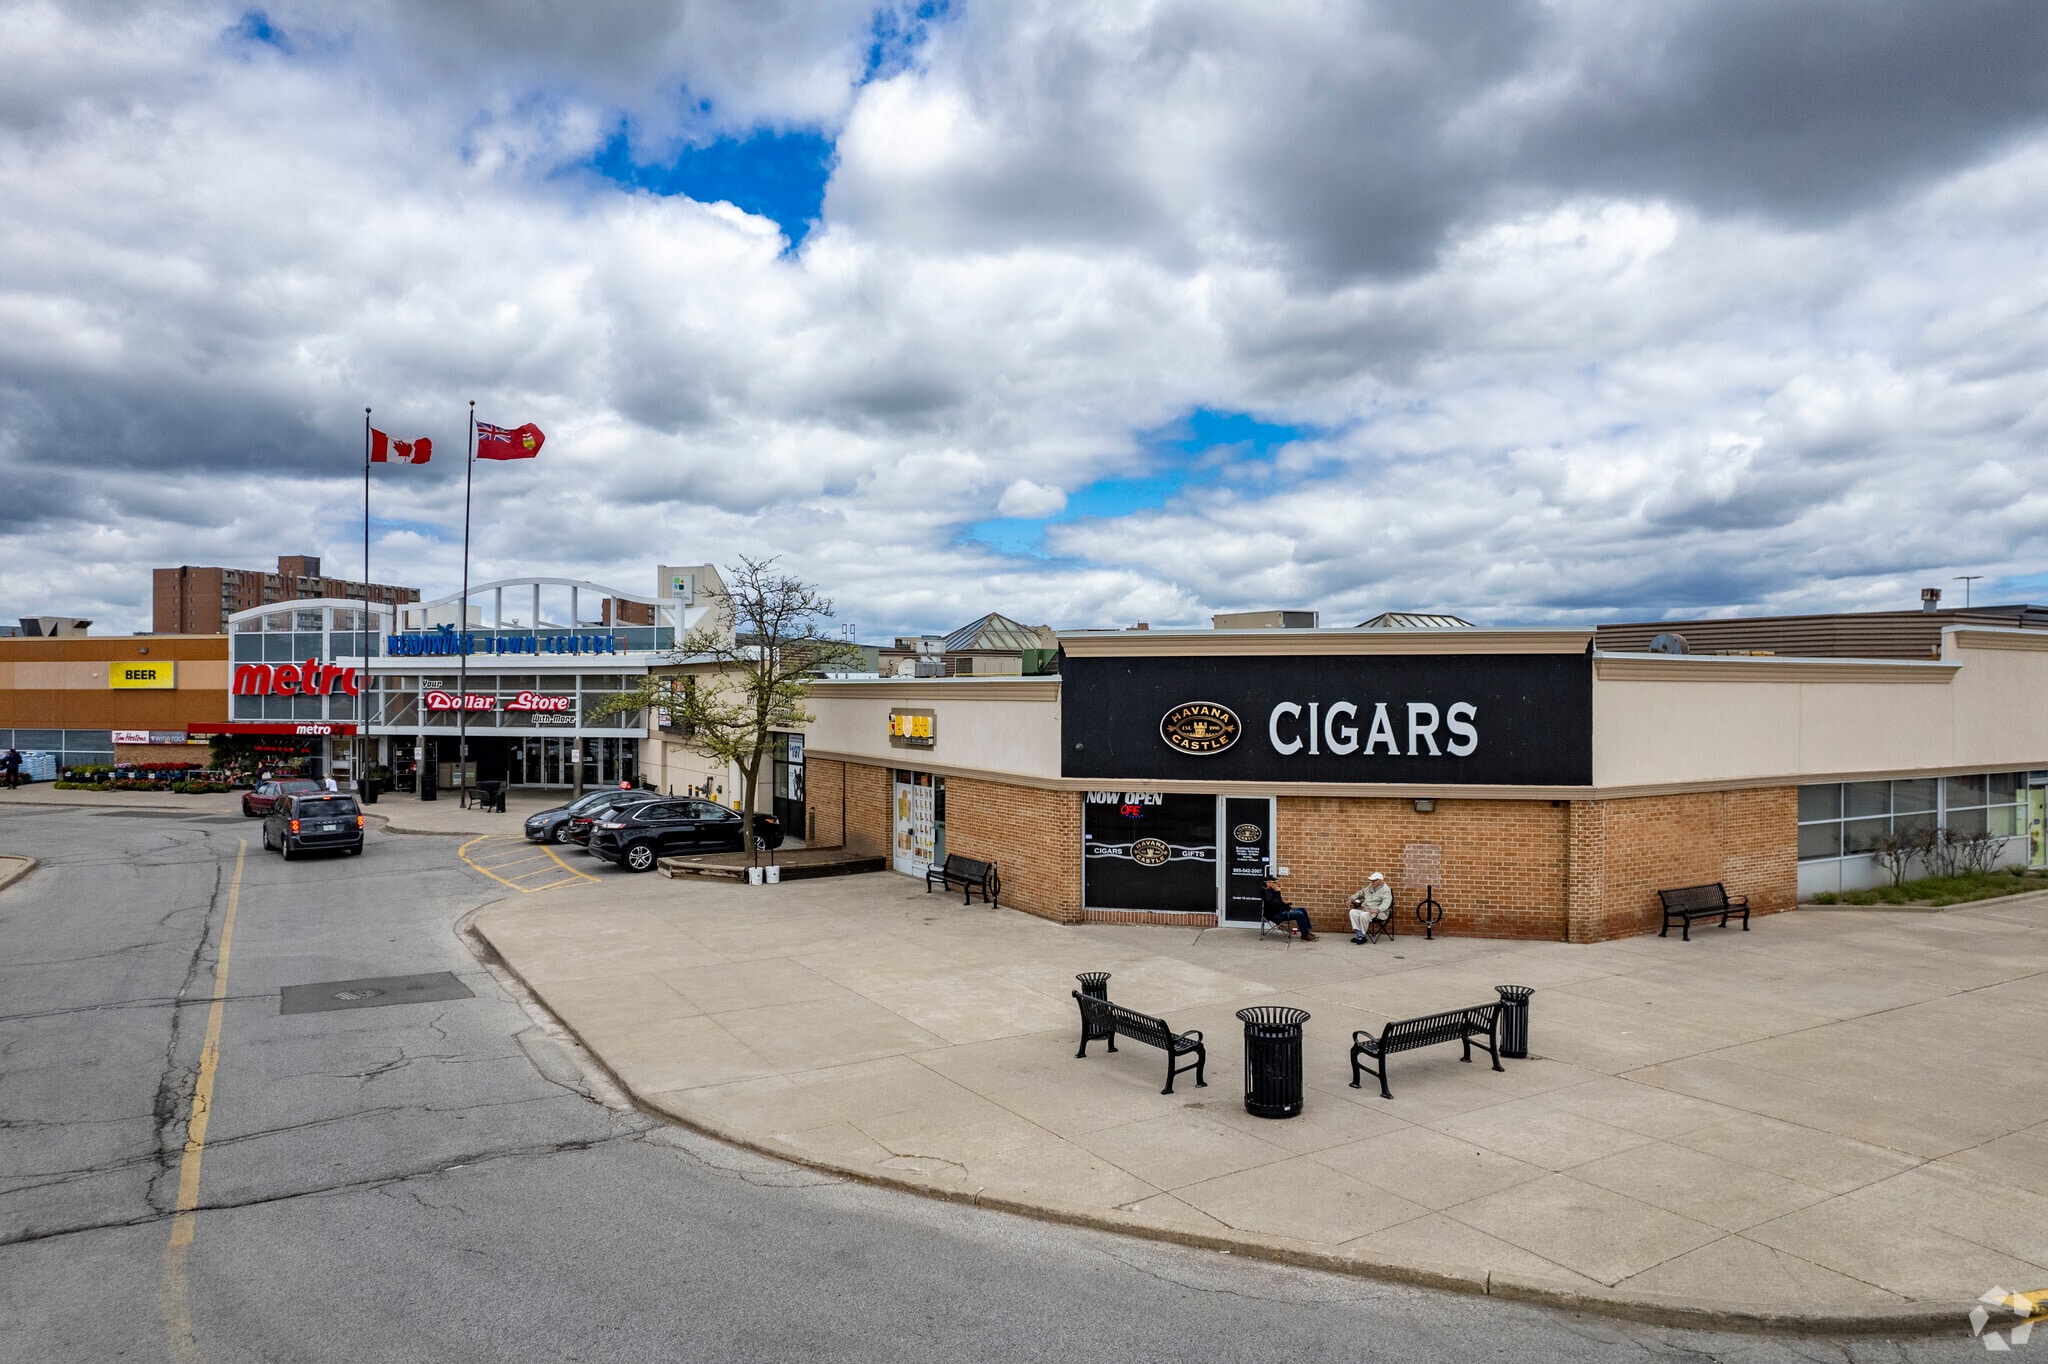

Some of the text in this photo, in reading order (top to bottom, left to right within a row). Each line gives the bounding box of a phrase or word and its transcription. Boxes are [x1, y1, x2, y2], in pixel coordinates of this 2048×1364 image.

[486, 636, 536, 654] TOWN
[546, 636, 614, 654] CENTRE
[125, 670, 156, 680] BEER
[232, 658, 373, 696] metro
[422, 680, 443, 688] Your
[427, 691, 570, 710] Dollar Store
[1172, 706, 1229, 722] HAVANA
[296, 724, 331, 734] metro
[1269, 702, 1478, 756] CIGARS
[115, 732, 124, 742] Tim
[1172, 734, 1228, 750] CASTLE
[1086, 791, 1163, 805] NOW OPEN
[1136, 840, 1166, 849] HAVANA
[1136, 854, 1165, 863] CASTLE
